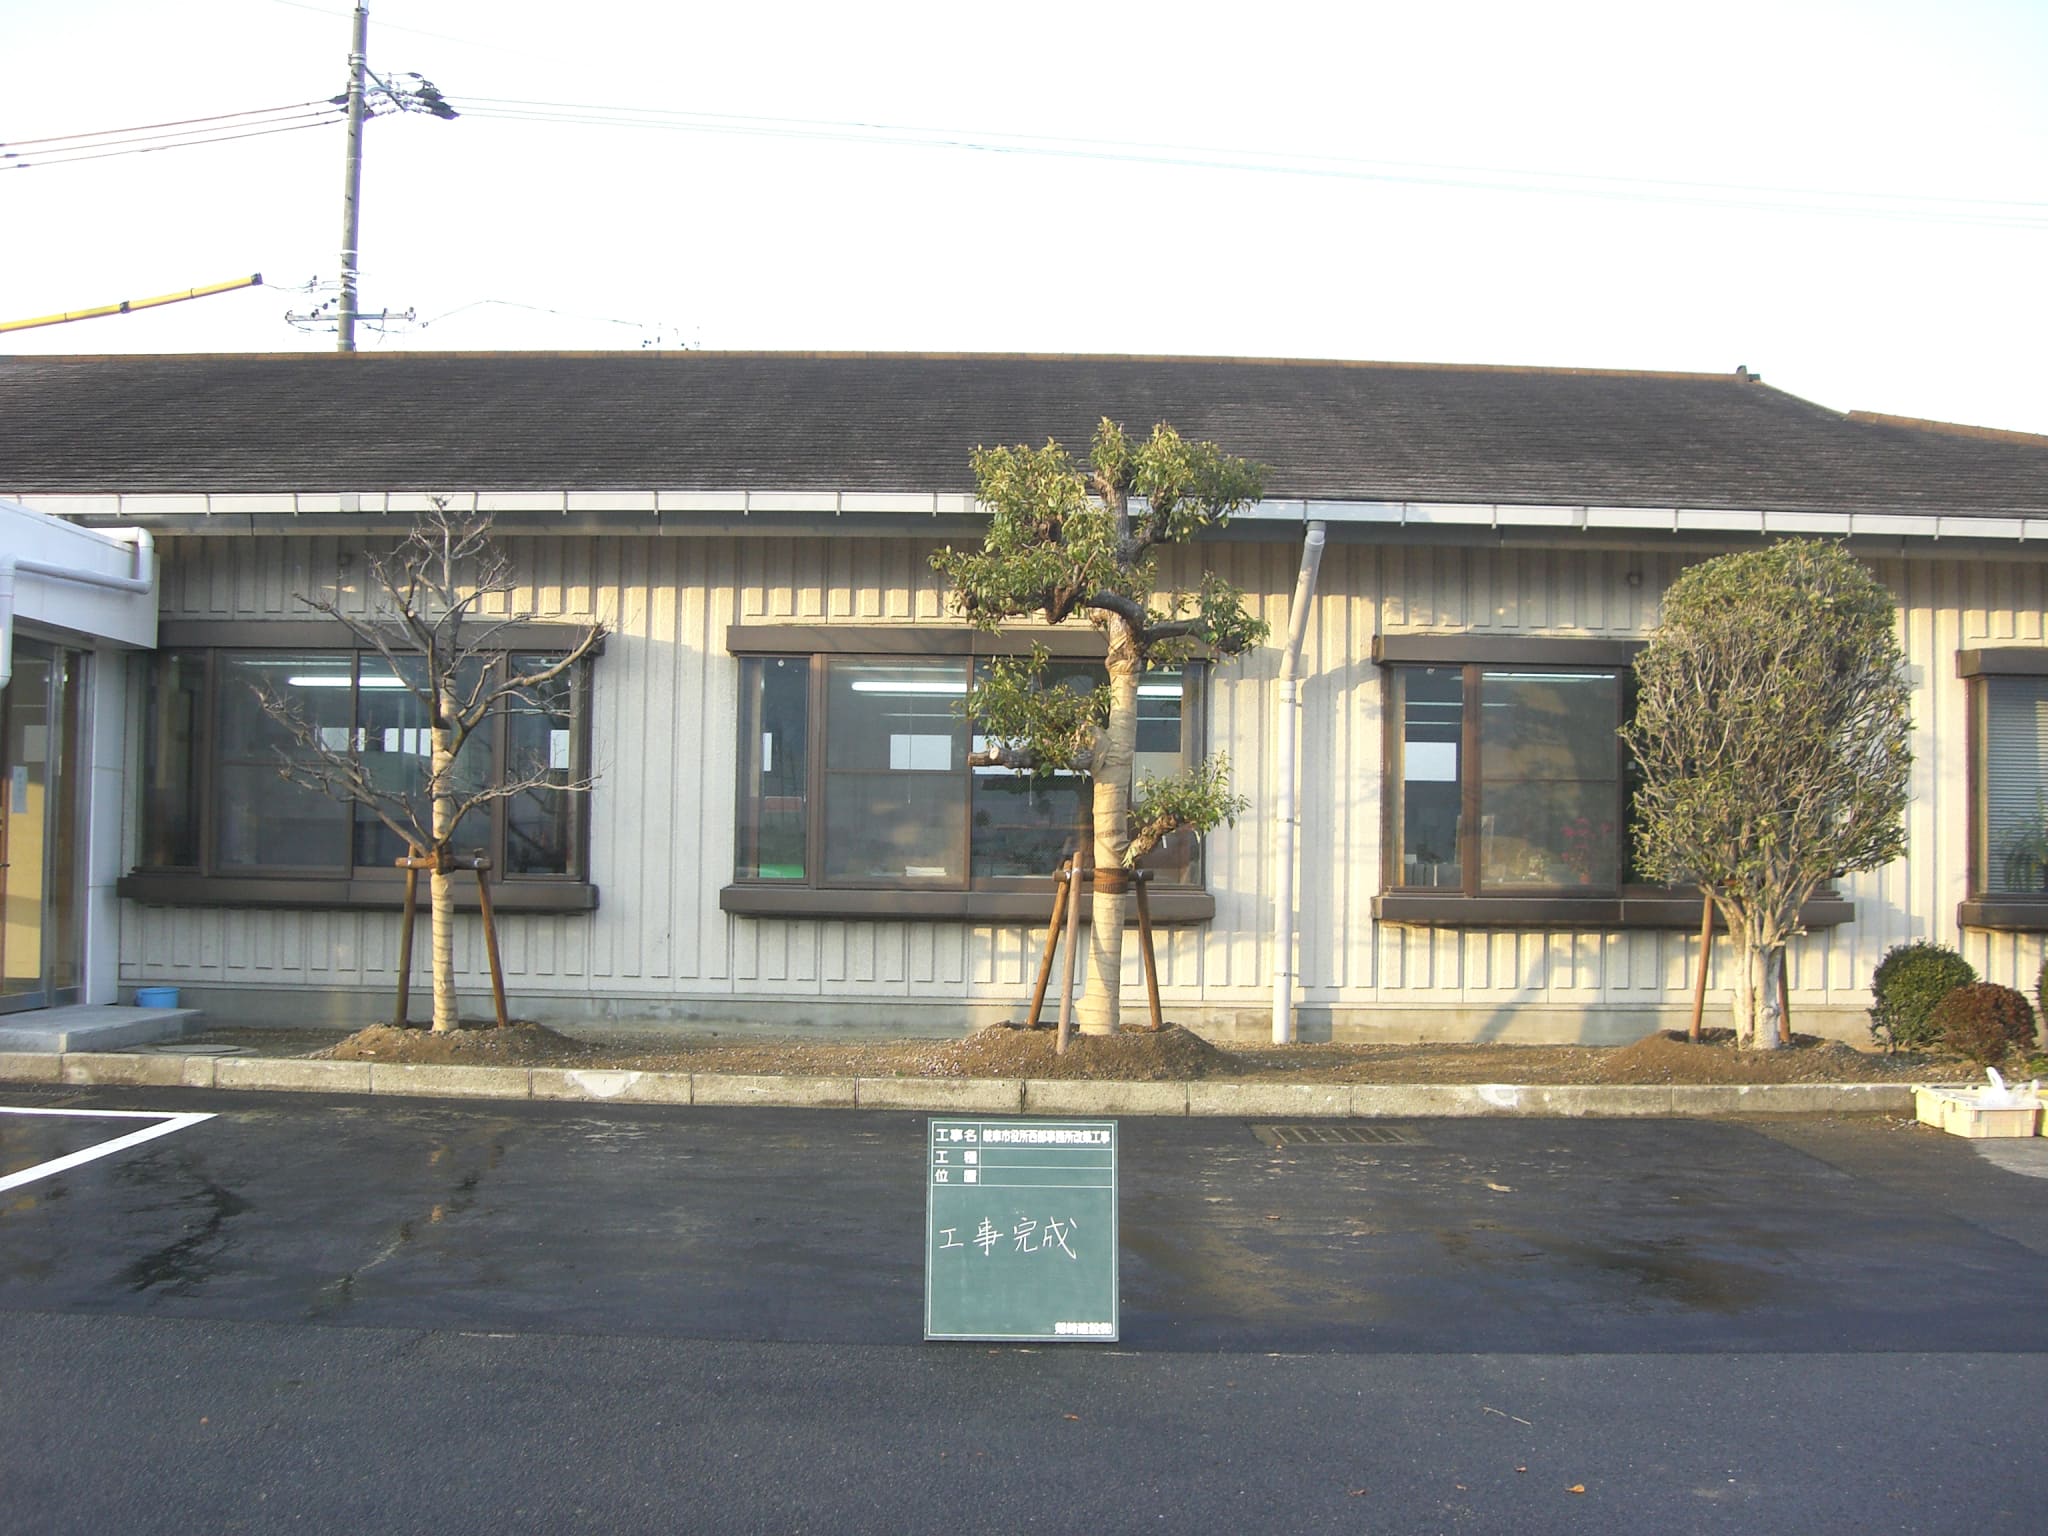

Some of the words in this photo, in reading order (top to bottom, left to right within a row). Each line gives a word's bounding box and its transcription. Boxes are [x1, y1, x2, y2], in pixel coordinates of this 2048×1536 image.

[935, 1129, 977, 1142] 工事名
[939, 1216, 1078, 1260] 工事完成
